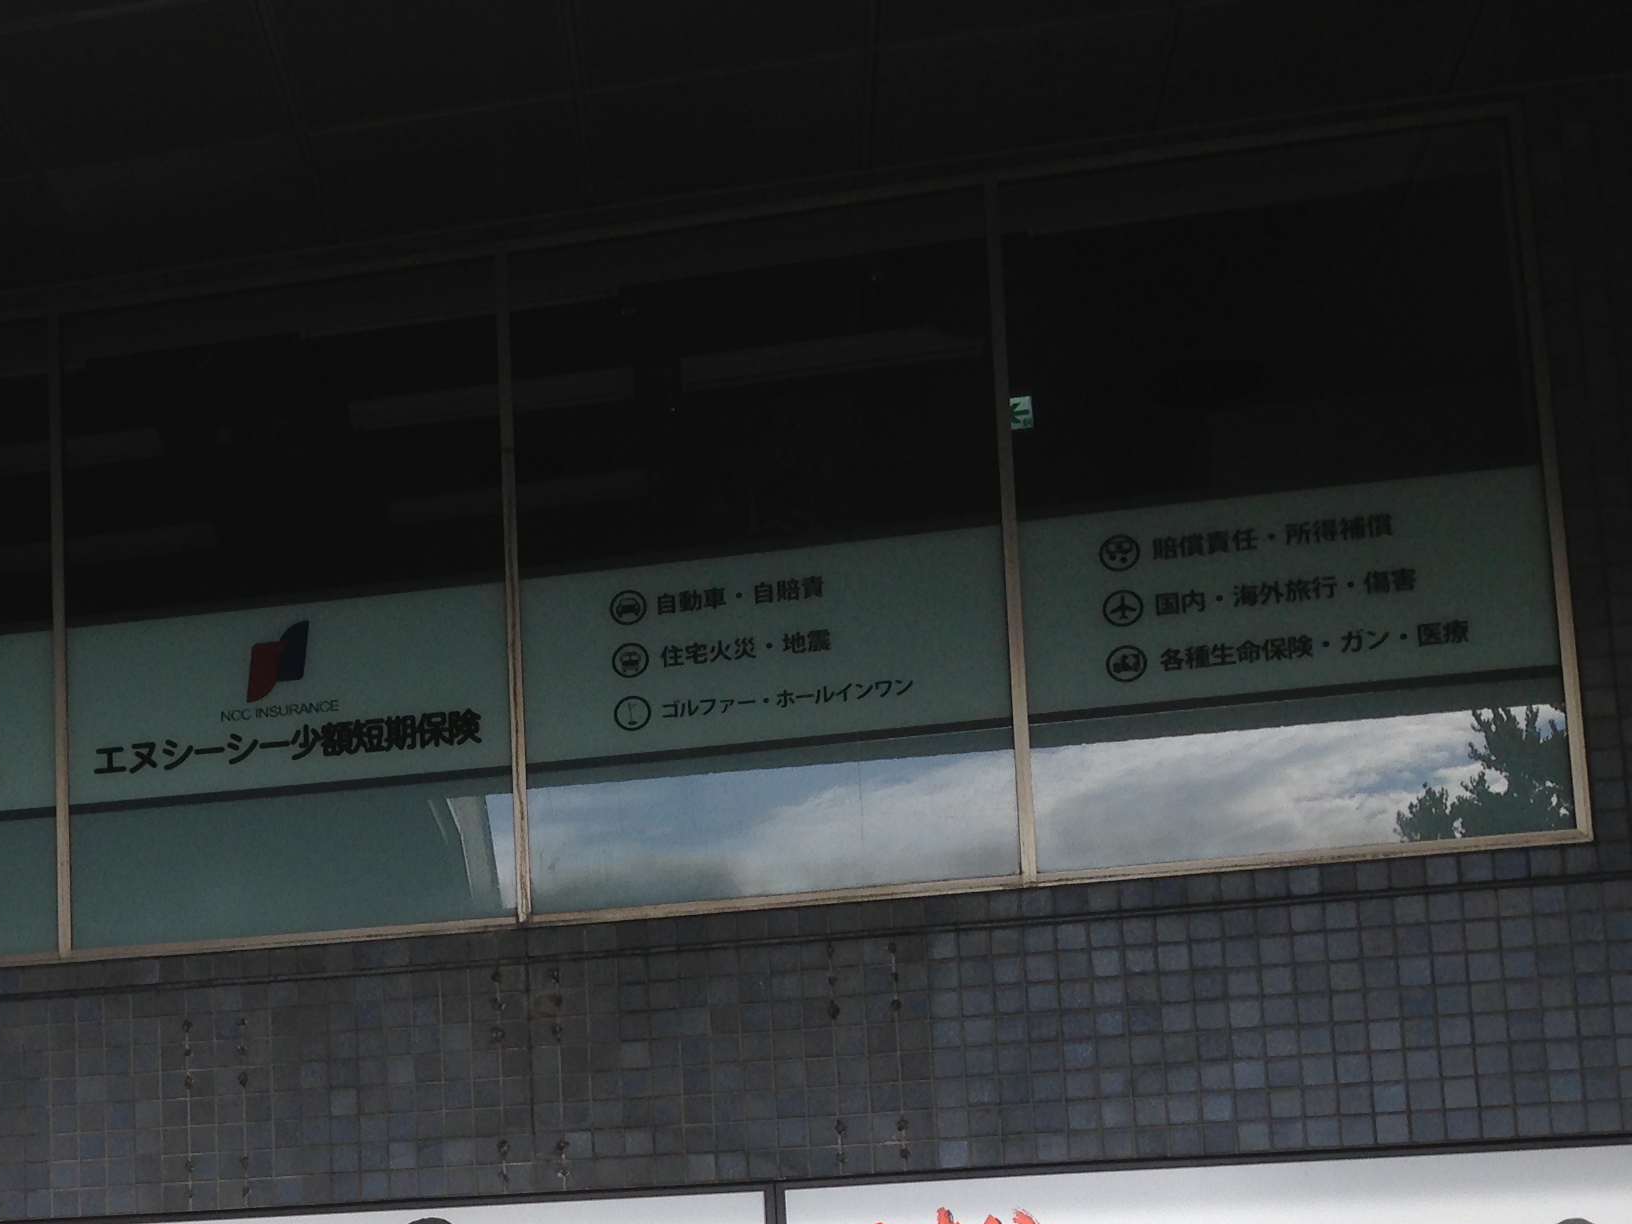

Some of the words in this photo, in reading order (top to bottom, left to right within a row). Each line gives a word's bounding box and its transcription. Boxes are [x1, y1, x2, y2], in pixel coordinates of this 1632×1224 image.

[656, 575, 825, 617] 自動車・自賠責
[660, 627, 831, 669] 住宅火災・地震
[221, 708, 251, 722] NCC
[255, 698, 340, 719] INSURANCE
[94, 709, 484, 776] エヌシーシー少額短期保険
